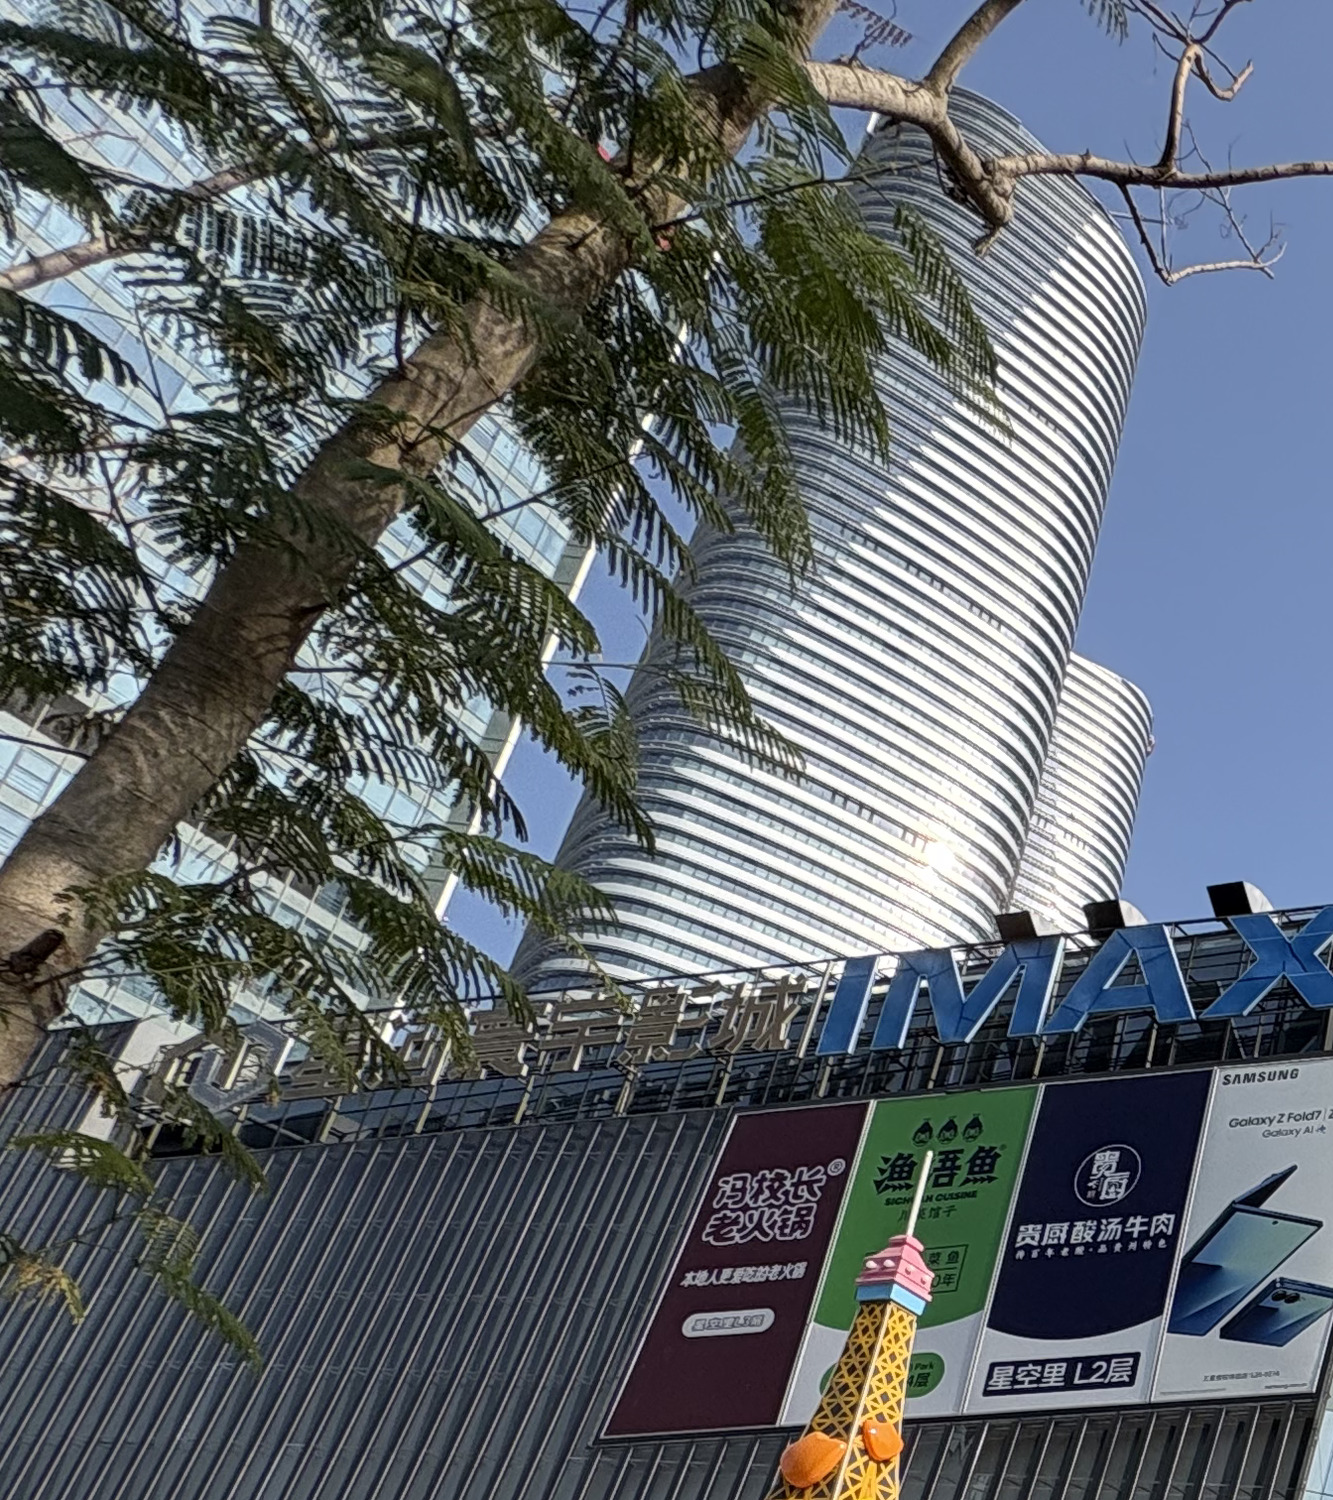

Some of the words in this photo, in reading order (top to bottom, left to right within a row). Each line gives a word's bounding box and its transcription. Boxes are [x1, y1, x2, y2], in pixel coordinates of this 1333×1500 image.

[1222, 1068, 1300, 1086] SAMSUNG
[1229, 1114, 1276, 1129] Galaxy
[1277, 1113, 1285, 1124] Z
[1287, 1110, 1322, 1123] Fold7
[1262, 1128, 1302, 1139] Galaxy
[713, 1166, 827, 1209] 冯校长
[884, 1194, 933, 1206] SICHAN
[936, 1190, 978, 1202] CUISINE
[702, 1203, 817, 1246] 老火锅
[1015, 1213, 1176, 1248] 贵厨酸汤牛肉
[680, 1262, 807, 1287] 本地人更爱吃的老火锅
[986, 1362, 1067, 1391] 星空里
[1073, 1357, 1134, 1386] L2层
